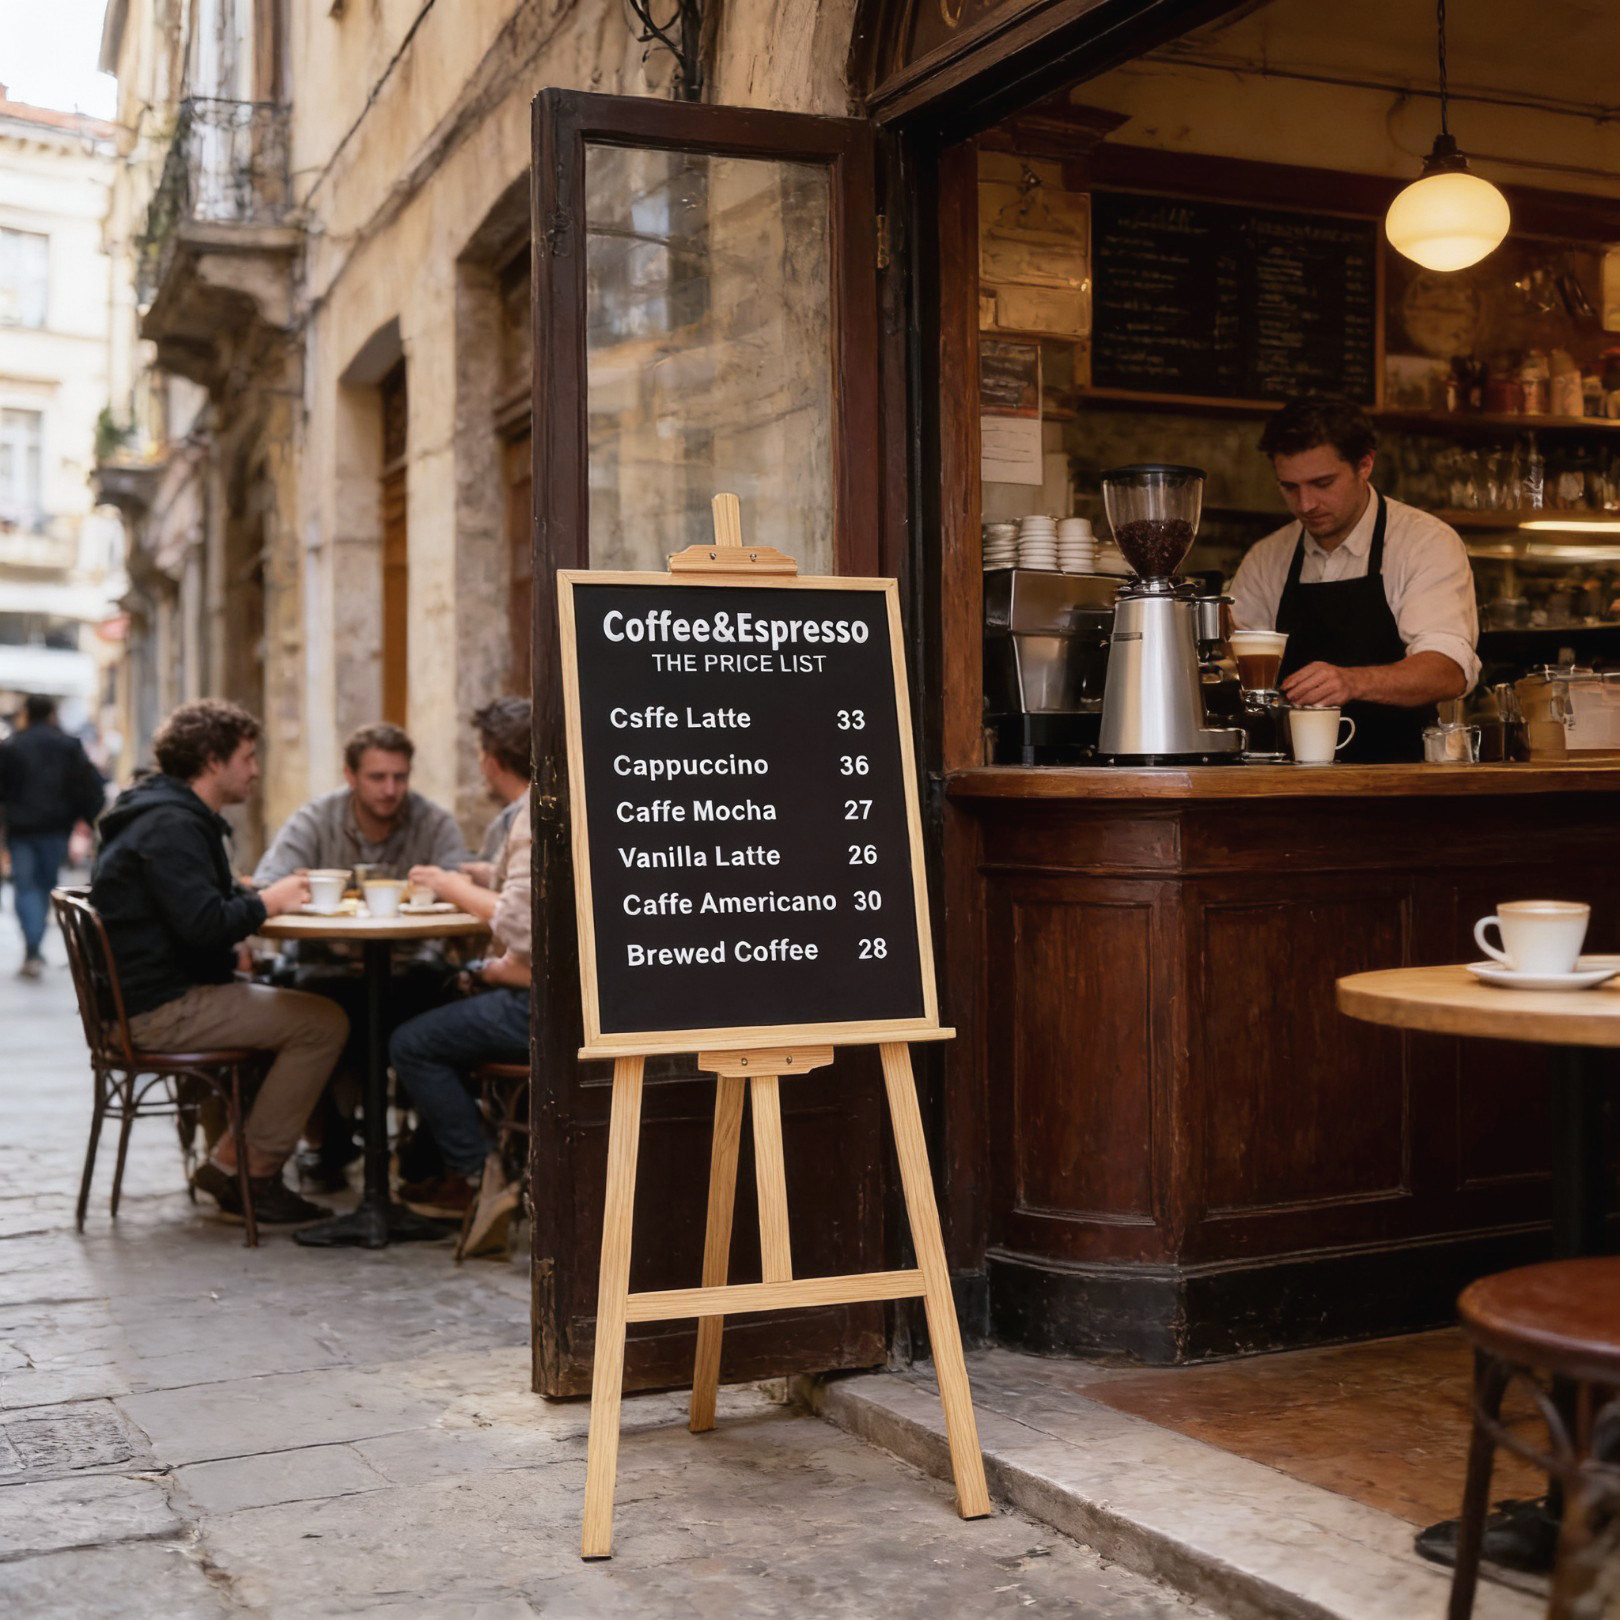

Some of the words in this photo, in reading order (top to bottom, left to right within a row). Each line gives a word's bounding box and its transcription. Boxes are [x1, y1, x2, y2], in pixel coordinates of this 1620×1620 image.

[603, 609, 869, 651] Coffee&Espresso
[651, 653, 698, 672] THE
[704, 654, 774, 673] PRICE
[779, 654, 827, 673] LIST
[686, 707, 751, 729] Latte
[836, 709, 866, 731] 33
[613, 753, 769, 782] Cappuccino
[839, 755, 870, 776] 36
[616, 799, 686, 823] Caffe
[692, 799, 777, 822] Mocha
[844, 799, 873, 820] 27
[617, 845, 708, 869] Vanilla
[715, 845, 781, 867] Latte
[848, 844, 878, 865] 26
[623, 892, 693, 916] Caffe
[699, 890, 837, 914] Americano
[853, 890, 882, 911] 30
[627, 940, 726, 967] Brewed
[734, 937, 819, 963] Coffee
[858, 937, 888, 960] 28
